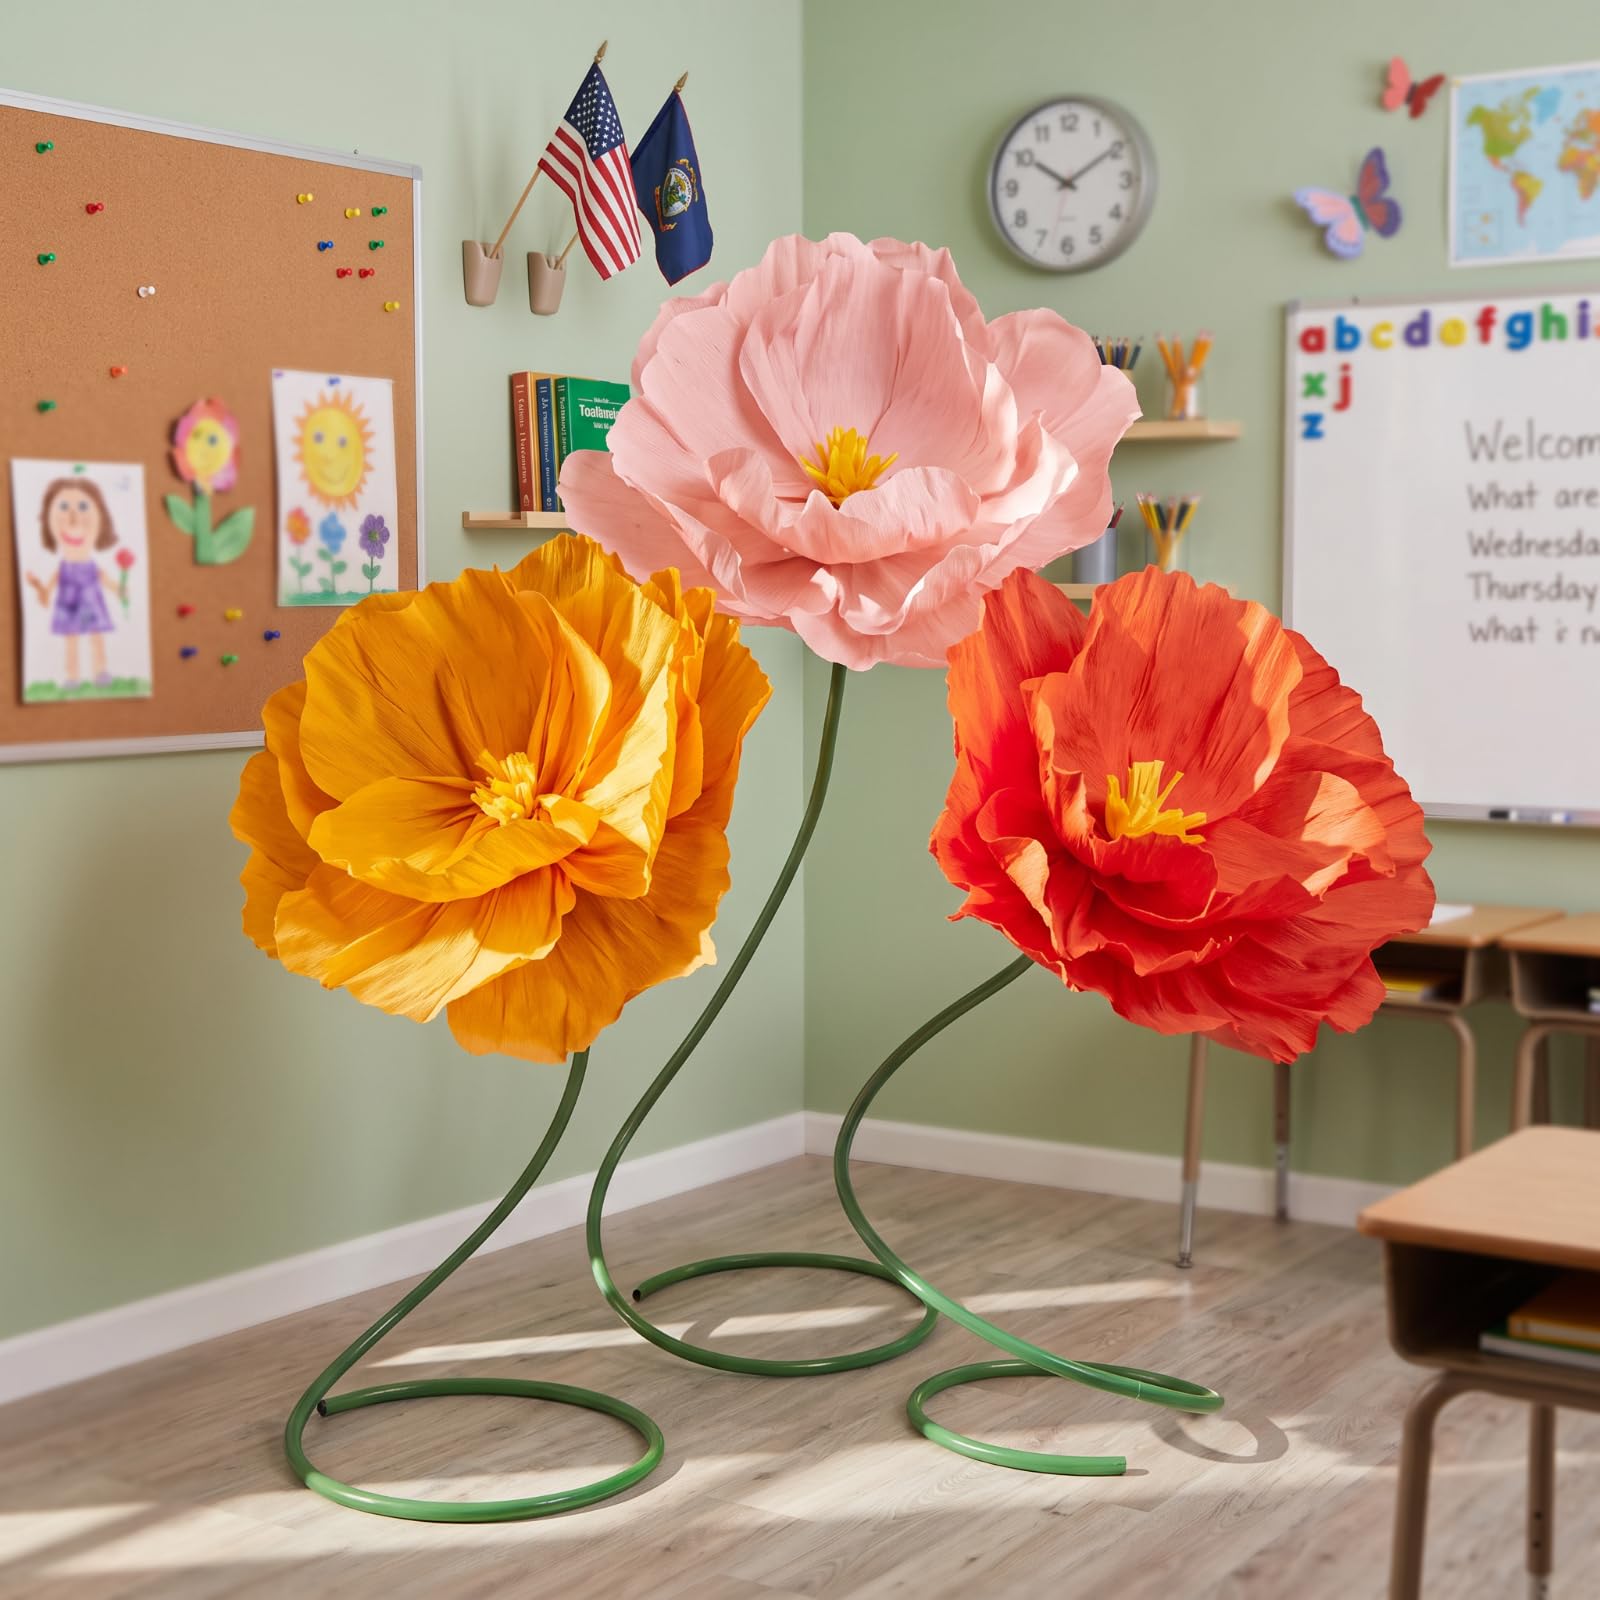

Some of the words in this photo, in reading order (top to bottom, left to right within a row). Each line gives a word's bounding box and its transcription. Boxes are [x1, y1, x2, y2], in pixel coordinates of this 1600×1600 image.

[1060, 113, 1079, 133] 12
[1093, 120, 1101, 136] 1
[1035, 125, 1049, 142] 11
[1016, 149, 1034, 167] 10
[1108, 141, 1124, 159] 2
[1005, 179, 1019, 198] 9
[1119, 171, 1133, 190] 3
[1014, 209, 1028, 228] 8
[1108, 204, 1122, 221] 4
[1036, 229, 1048, 247] 7
[1089, 226, 1102, 245] 5
[1060, 236, 1075, 256] 6
[1301, 412, 1325, 440] z
[1467, 481, 1538, 511] What
[1554, 488, 1599, 508] are
[1467, 529, 1600, 558] Wednesda
[1467, 571, 1598, 613] Thursday
[1468, 615, 1539, 644] What
